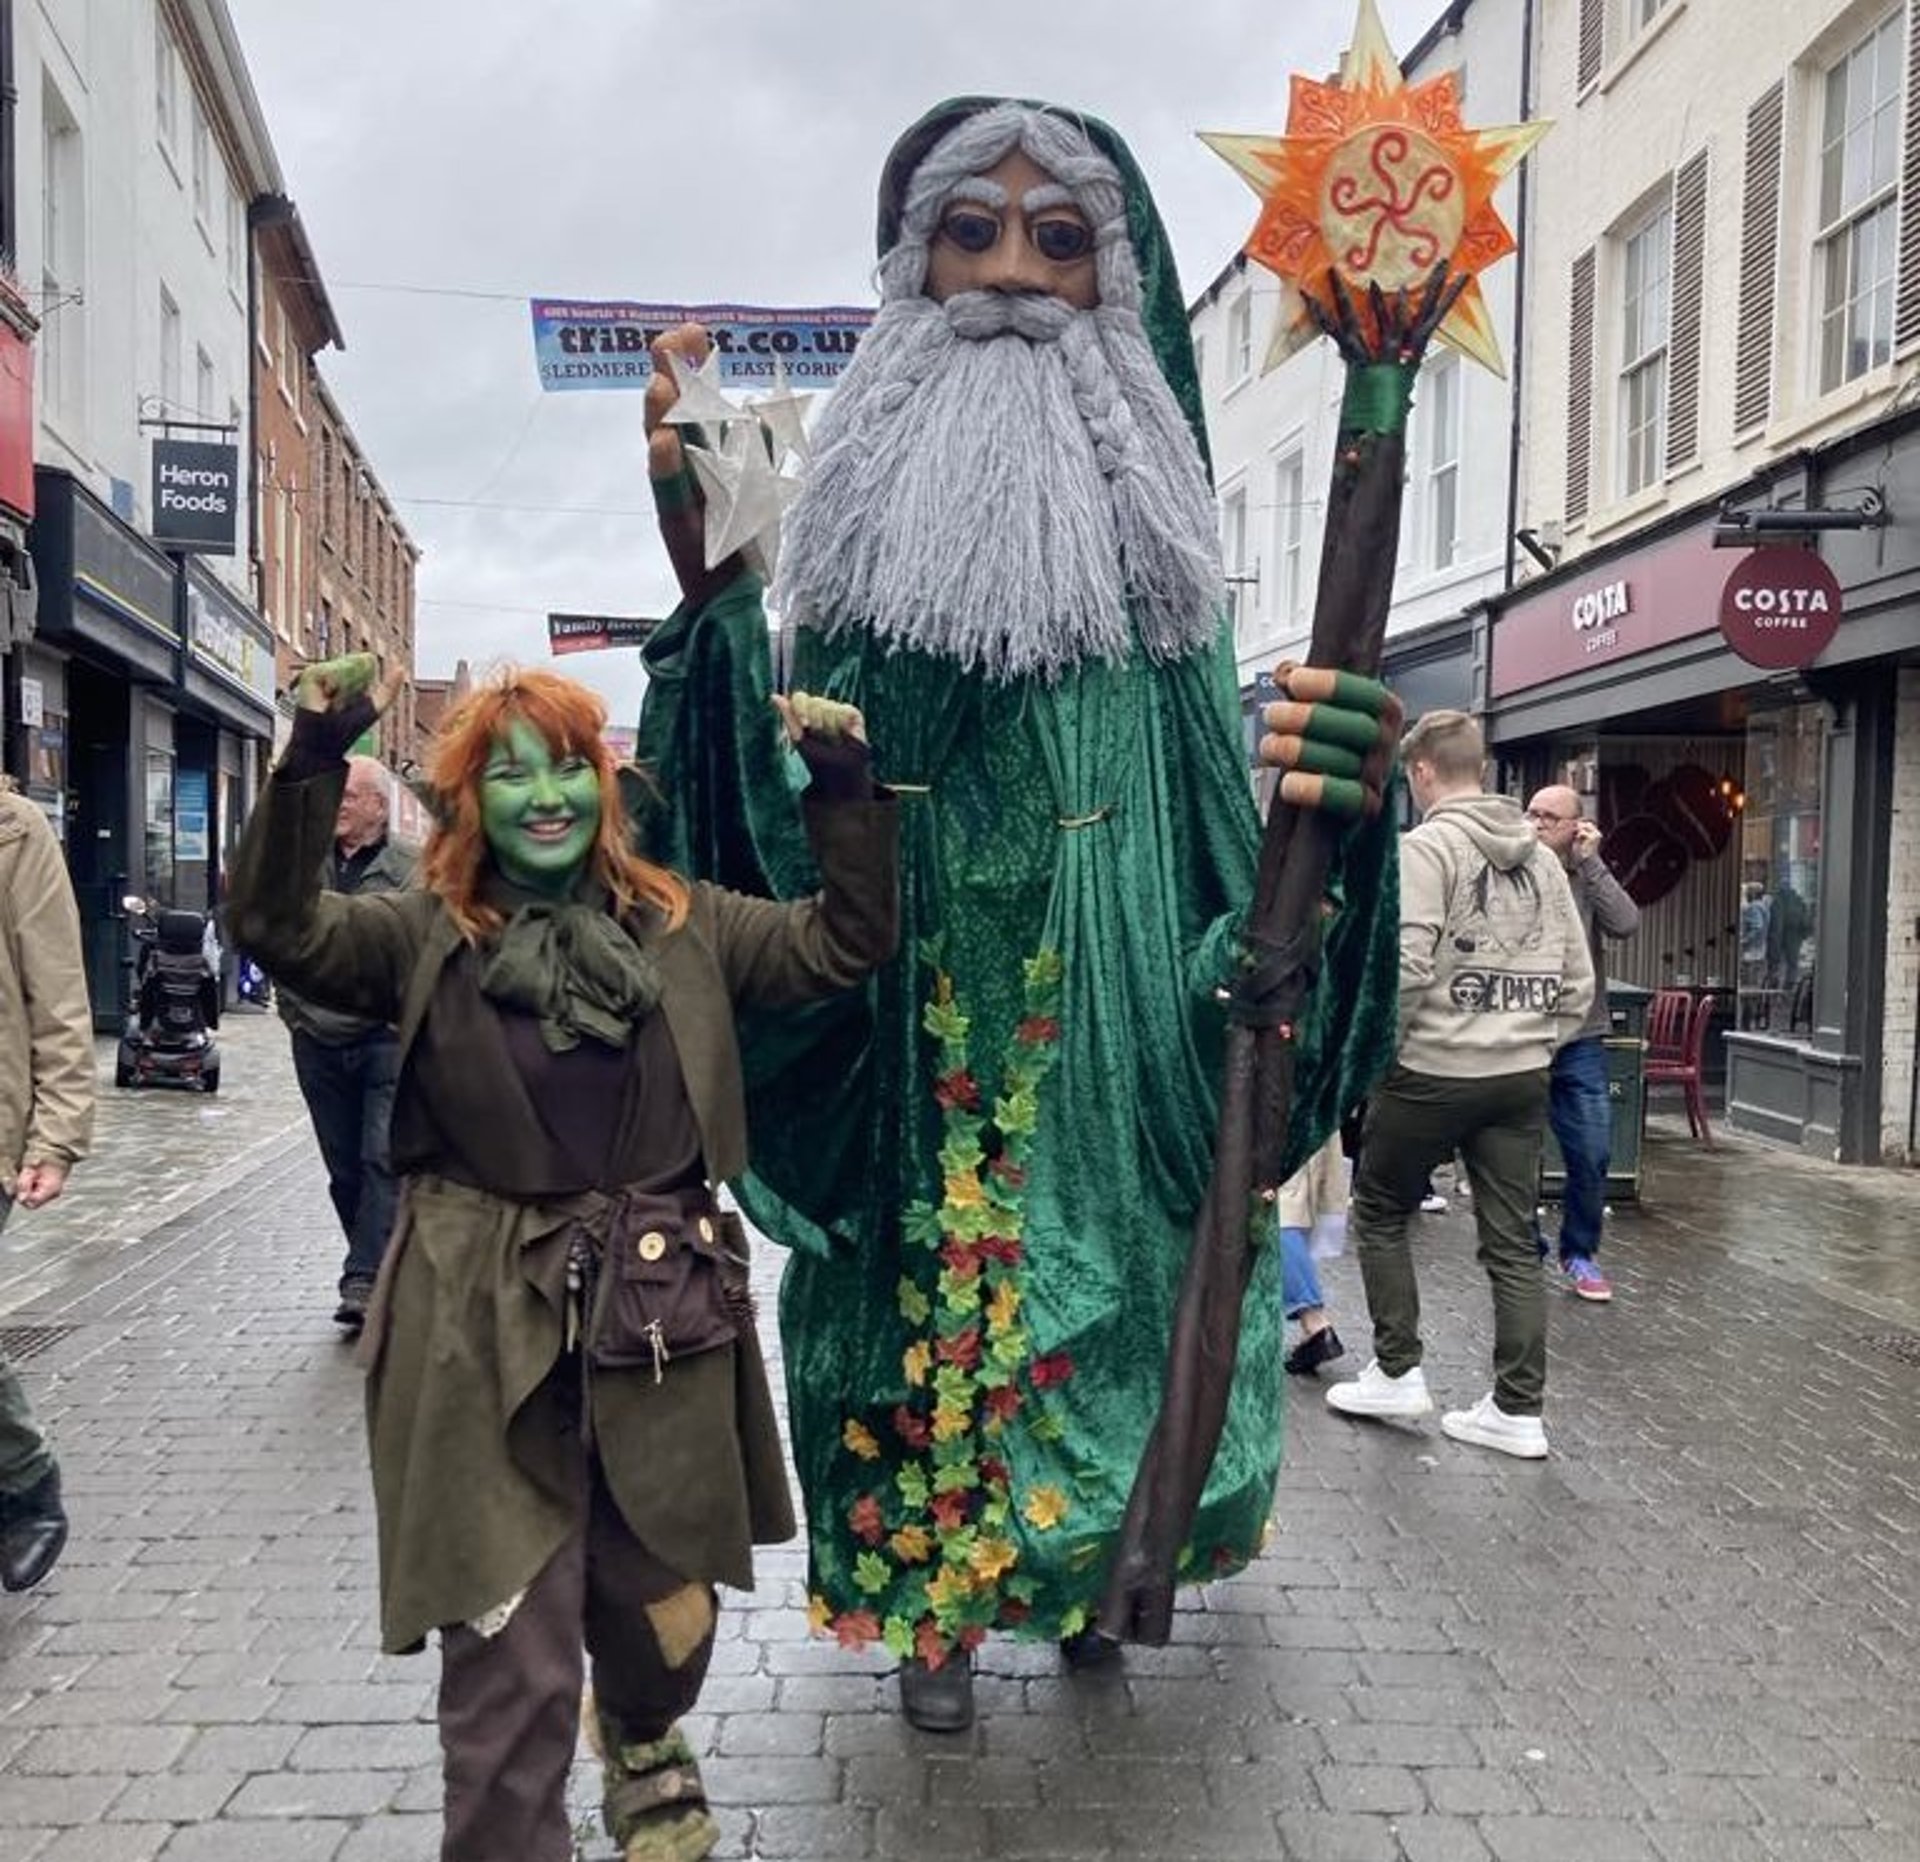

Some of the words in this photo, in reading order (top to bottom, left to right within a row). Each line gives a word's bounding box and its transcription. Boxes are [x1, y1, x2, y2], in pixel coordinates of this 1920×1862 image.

[160, 464, 229, 488] Heron
[161, 488, 228, 513] Foods
[1572, 581, 1630, 631] COSTA
[1734, 588, 1829, 614] COSTA
[1754, 616, 1808, 629] COFFEE
